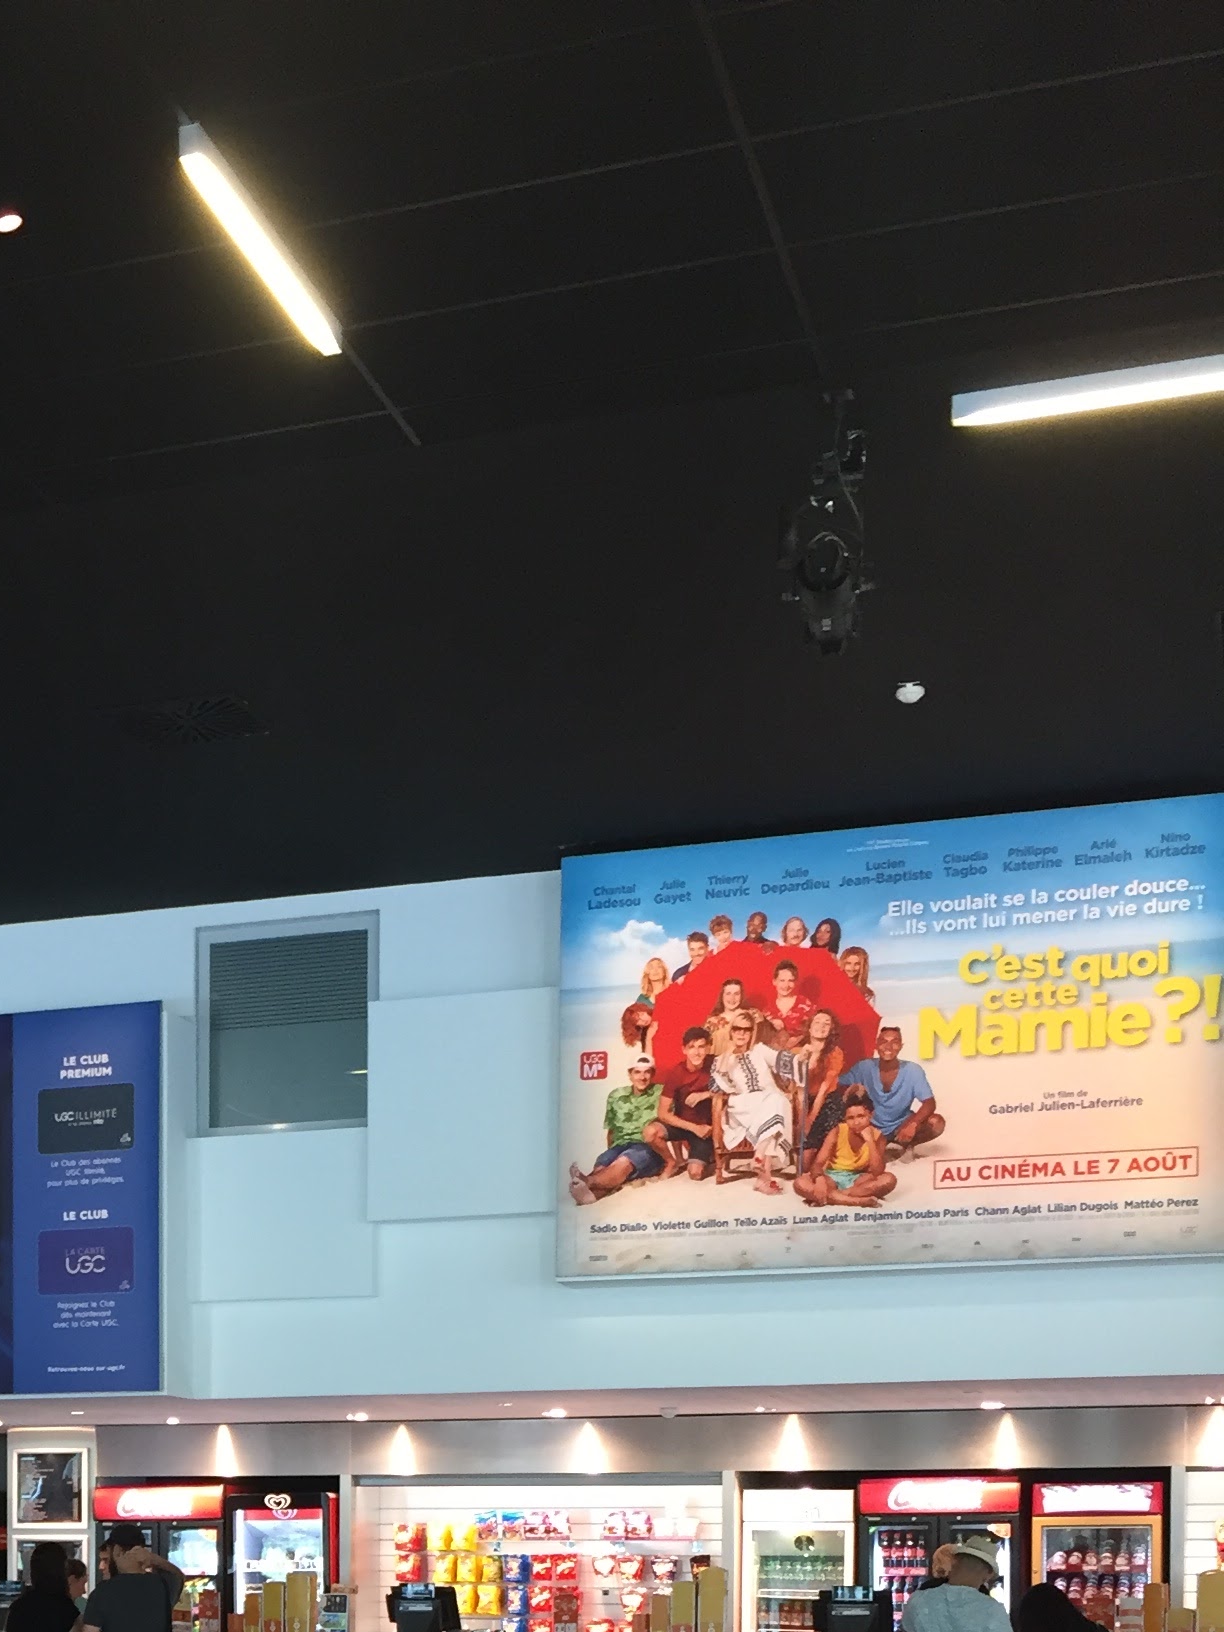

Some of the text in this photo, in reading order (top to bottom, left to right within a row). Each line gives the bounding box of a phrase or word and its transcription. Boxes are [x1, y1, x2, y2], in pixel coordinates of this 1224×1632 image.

[943, 851, 989, 864] Claudia
[1007, 845, 1059, 858] Philippe
[1075, 850, 1132, 866] Elmaleh
[1144, 843, 1206, 859] Kirtadze
[865, 858, 906, 872] Lucien
[943, 864, 988, 879] Tagbo
[1002, 858, 1063, 873] Katerine
[781, 866, 810, 879] Julie
[839, 869, 933, 888] Jean-Baptiste
[660, 879, 686, 891] Julie
[707, 874, 749, 886] Thierry
[761, 878, 831, 895] Depardieu
[593, 883, 636, 897] Chantal
[705, 886, 750, 900] Neuvic
[587, 897, 642, 910] Ladesou
[653, 891, 692, 905] Gayet
[888, 878, 1206, 917] Elle voulait se la couler douce...
[933, 915, 977, 933] vont
[982, 911, 1006, 928] lui
[1012, 909, 1078, 926] mener
[1084, 904, 1101, 919] la
[1106, 901, 1137, 917] vie
[1143, 897, 1191, 915] dure
[959, 940, 1170, 987] C'est quoi
[983, 980, 1078, 1011] cette
[918, 993, 1151, 1061] Mamie
[63, 1053, 109, 1066] LE CLUB
[584, 1054, 604, 1063] UGC
[60, 1066, 112, 1080] PREMIUM
[1058, 1091, 1074, 1099] film
[988, 1097, 1144, 1115] Gabriel Julien-Laferrière
[54, 1111, 75, 1122] UGC
[940, 1152, 1193, 1182] AU CINÉMA LE 7 AOÛT
[975, 1204, 1042, 1216] Chann Aglat
[1047, 1201, 1118, 1213] Lilian Dugois
[1124, 1198, 1199, 1210] Mattéo Perez
[63, 1209, 109, 1221] LE CLUB
[793, 1213, 848, 1225] Luna Aglat
[854, 1208, 969, 1223] Benjamin Douba Paris
[590, 1223, 648, 1233] Sadio Diallo
[652, 1219, 729, 1231] Violette Guillon
[65, 1254, 106, 1274] UGC
